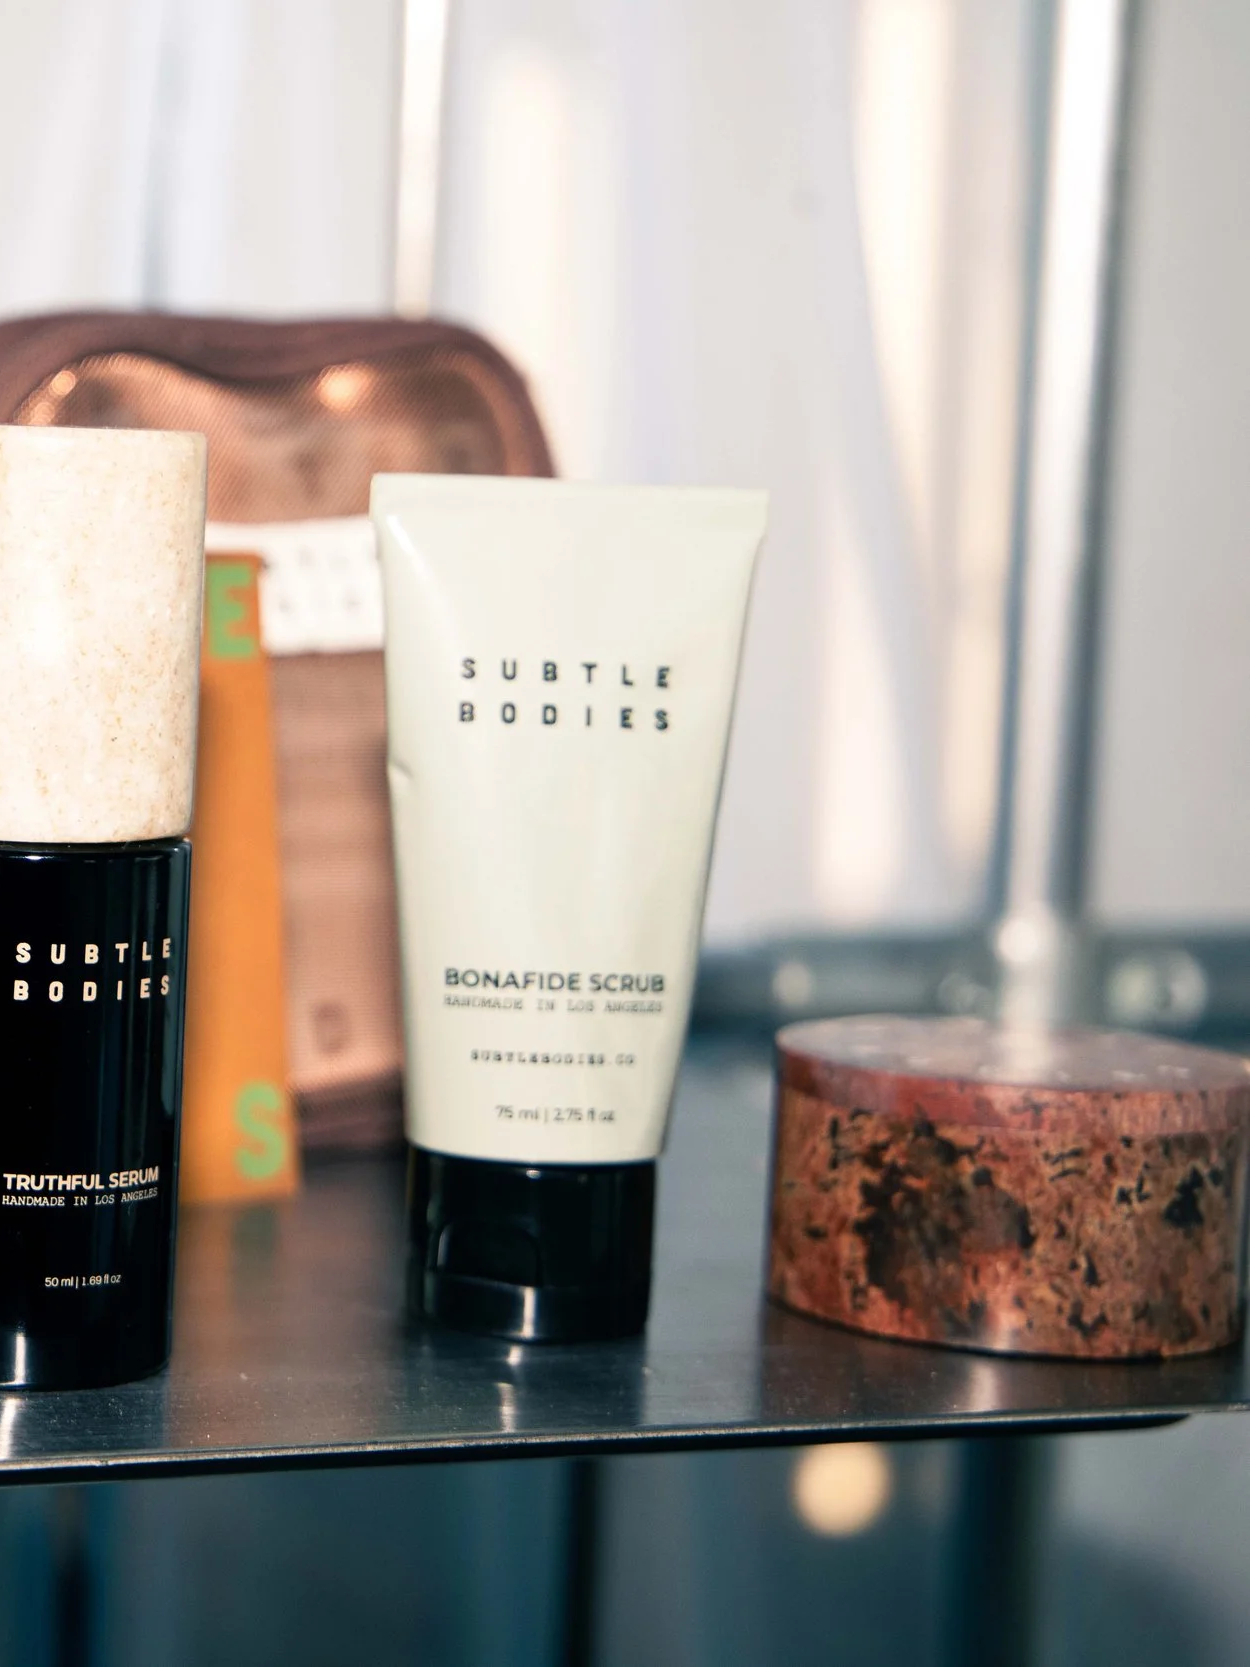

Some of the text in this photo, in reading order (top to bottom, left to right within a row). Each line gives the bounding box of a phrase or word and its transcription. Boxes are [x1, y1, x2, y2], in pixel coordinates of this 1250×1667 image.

[461, 658, 671, 690] SUBTLE
[459, 702, 670, 732] BODIES
[15, 937, 171, 965] SUBTLE
[13, 974, 170, 1002] BODIES
[444, 967, 666, 993] BONAFIDE SCRUB
[443, 994, 664, 1014] HANDMADE IN LOS ANGELES
[495, 1104, 514, 1120] 75
[518, 1106, 539, 1120] ml
[2, 1165, 159, 1191] TRUTHFUL SERUM
[2, 1186, 158, 1206] HANDMADE IN LOS ANGELES
[44, 1276, 59, 1287] 50
[61, 1275, 74, 1287] ml
[82, 1274, 102, 1286] 1.69
[103, 1273, 110, 1284] fl
[111, 1273, 122, 1284] oz
